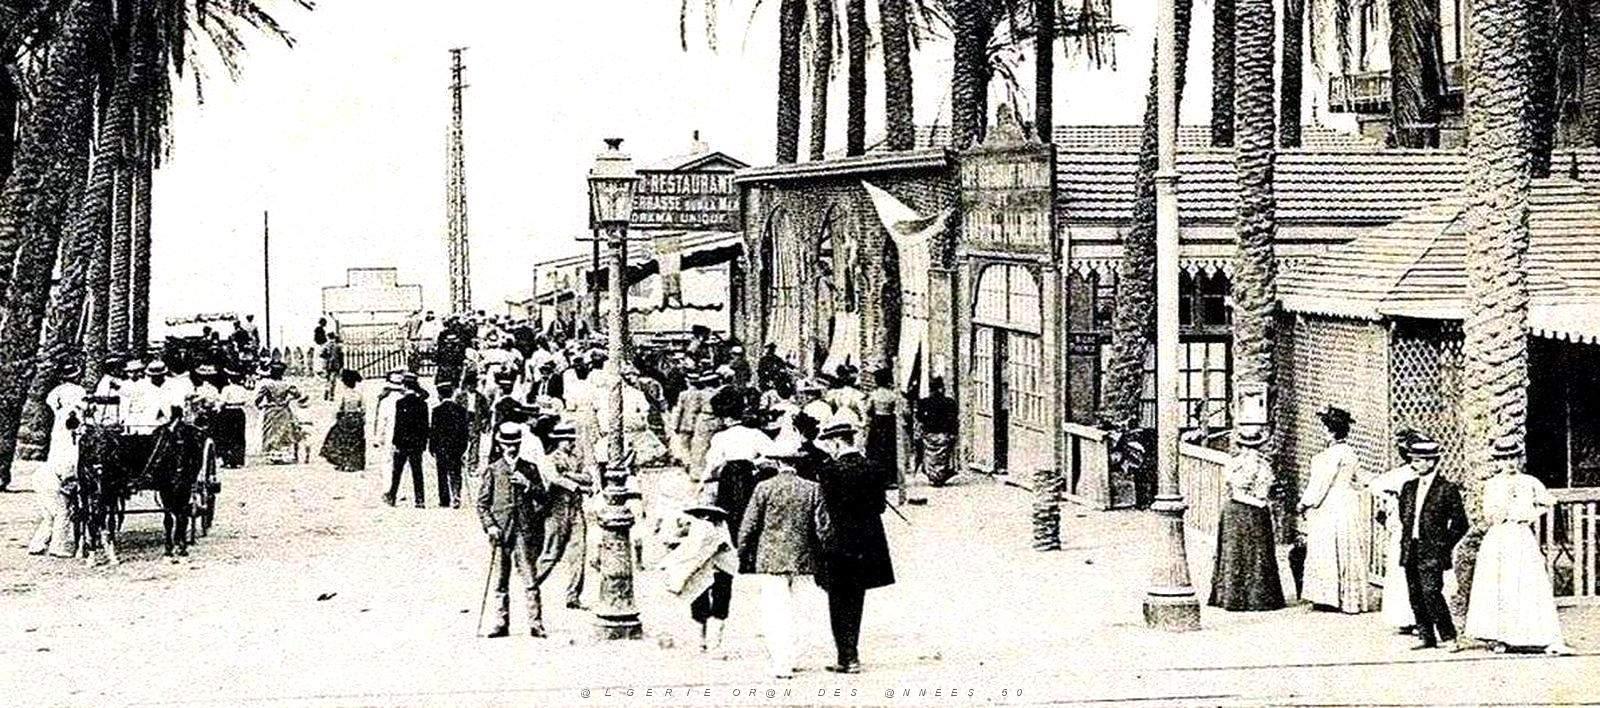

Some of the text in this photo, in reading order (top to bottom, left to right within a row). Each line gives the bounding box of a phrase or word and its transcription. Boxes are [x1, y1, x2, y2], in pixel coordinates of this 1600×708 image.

[651, 174, 734, 194] RESTAURANT
[632, 195, 681, 211] ERRASSE
[680, 213, 728, 225] UNIQUE
